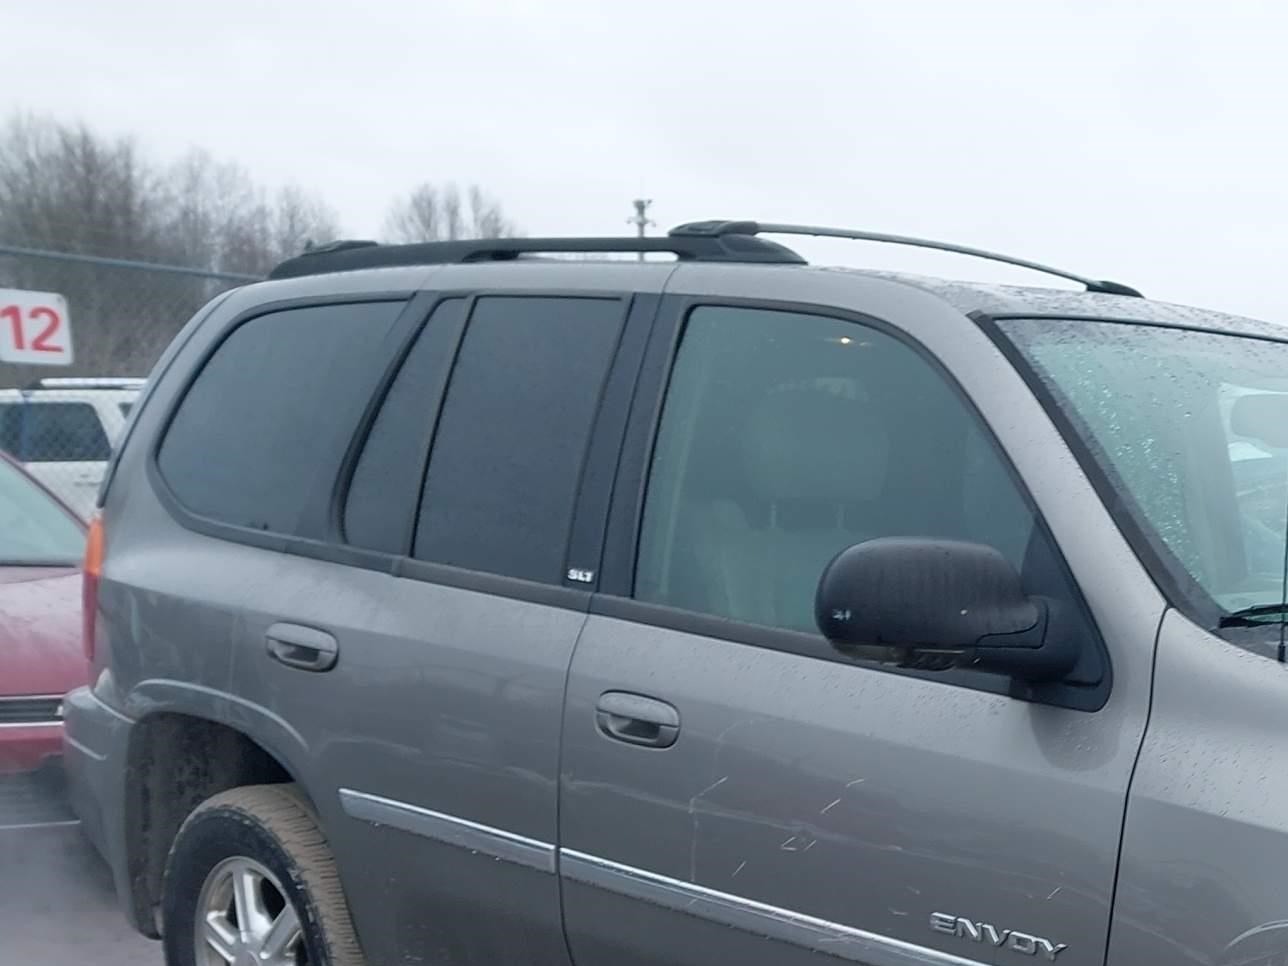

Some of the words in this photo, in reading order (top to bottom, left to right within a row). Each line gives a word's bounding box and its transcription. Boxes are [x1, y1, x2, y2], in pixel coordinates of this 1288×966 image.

[0, 304, 64, 353] 12
[567, 568, 593, 582] SLT
[929, 911, 1068, 961] ENVOY
